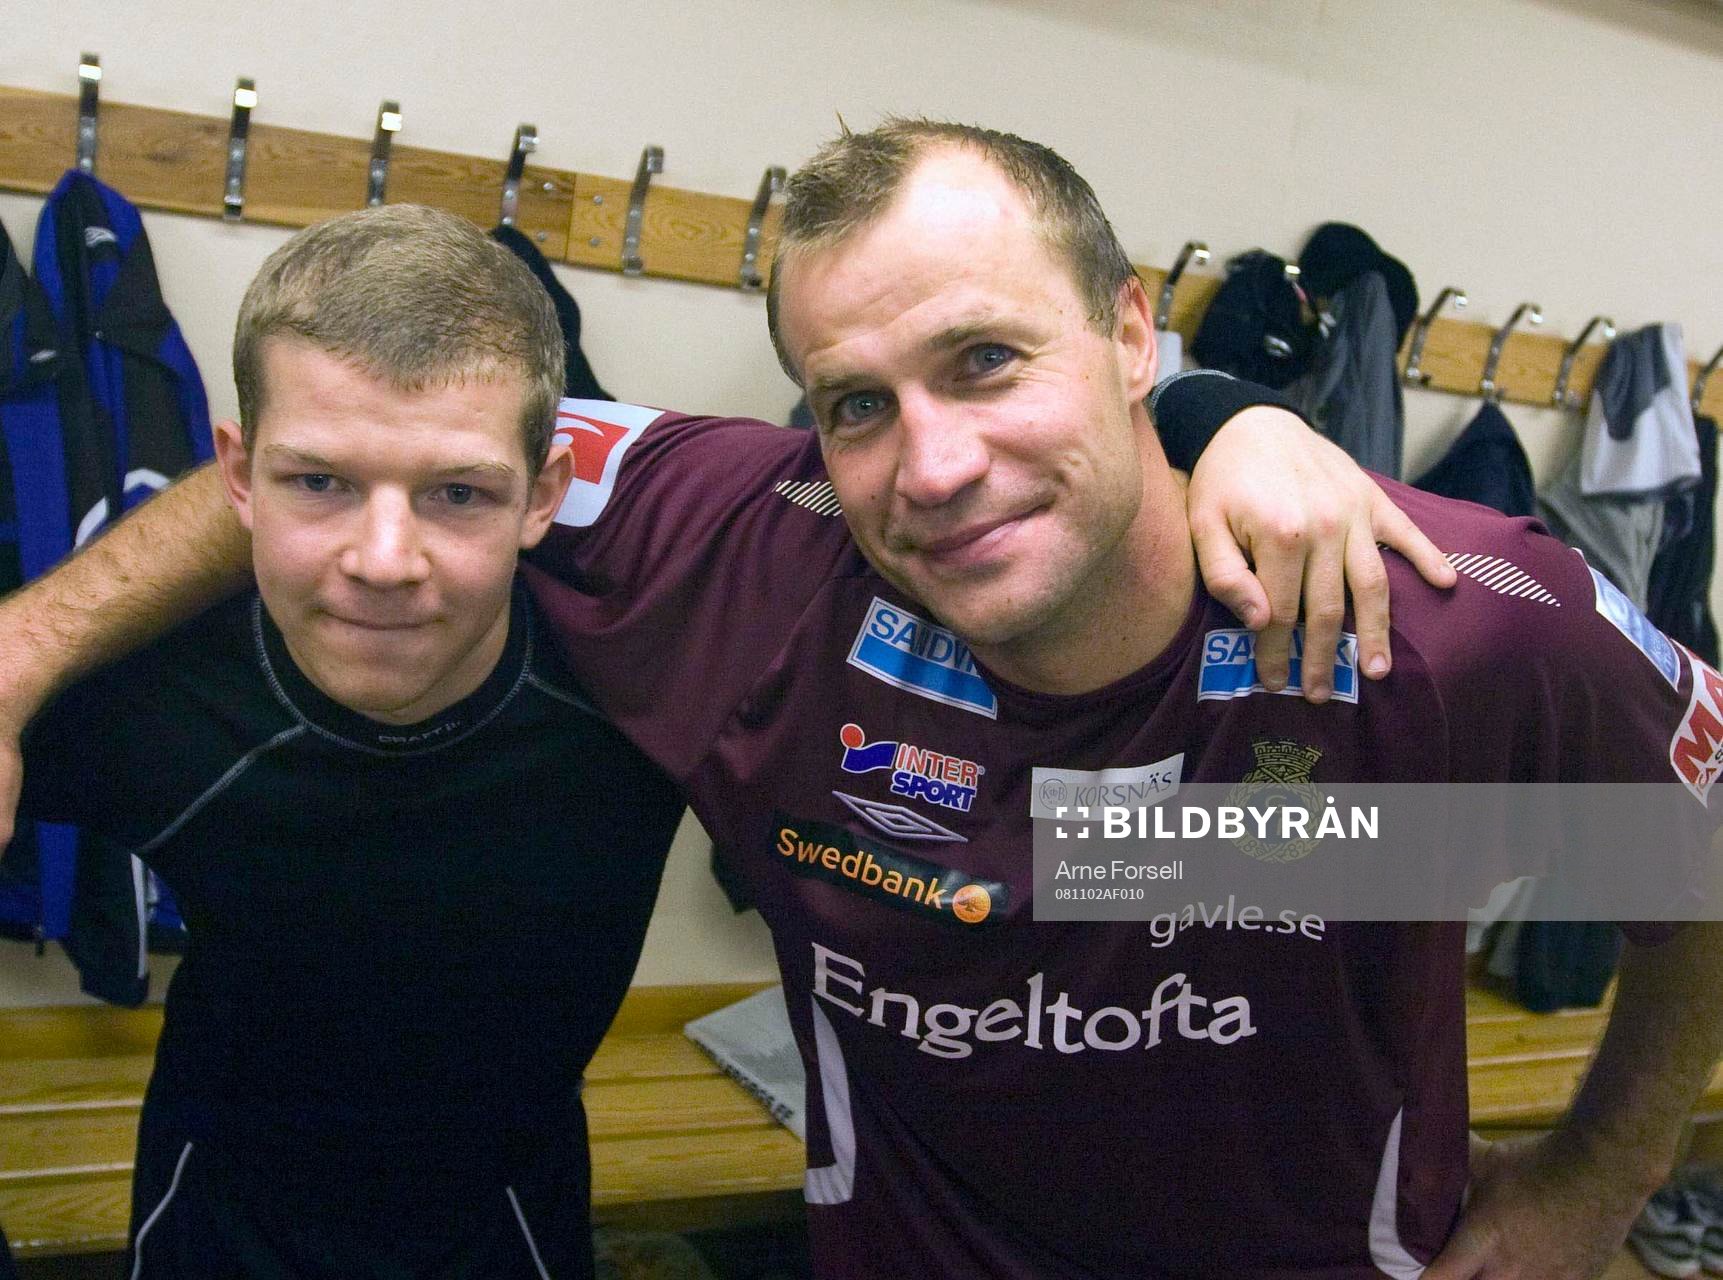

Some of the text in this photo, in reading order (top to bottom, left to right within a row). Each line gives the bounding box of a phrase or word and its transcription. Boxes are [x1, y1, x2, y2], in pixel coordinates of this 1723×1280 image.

[896, 743, 978, 787] INTER
[890, 770, 977, 812] SPORT
[1073, 771, 1173, 807] KORSNÄS
[776, 828, 949, 910] Swedbank
[811, 942, 1257, 1060] Engeltofta
